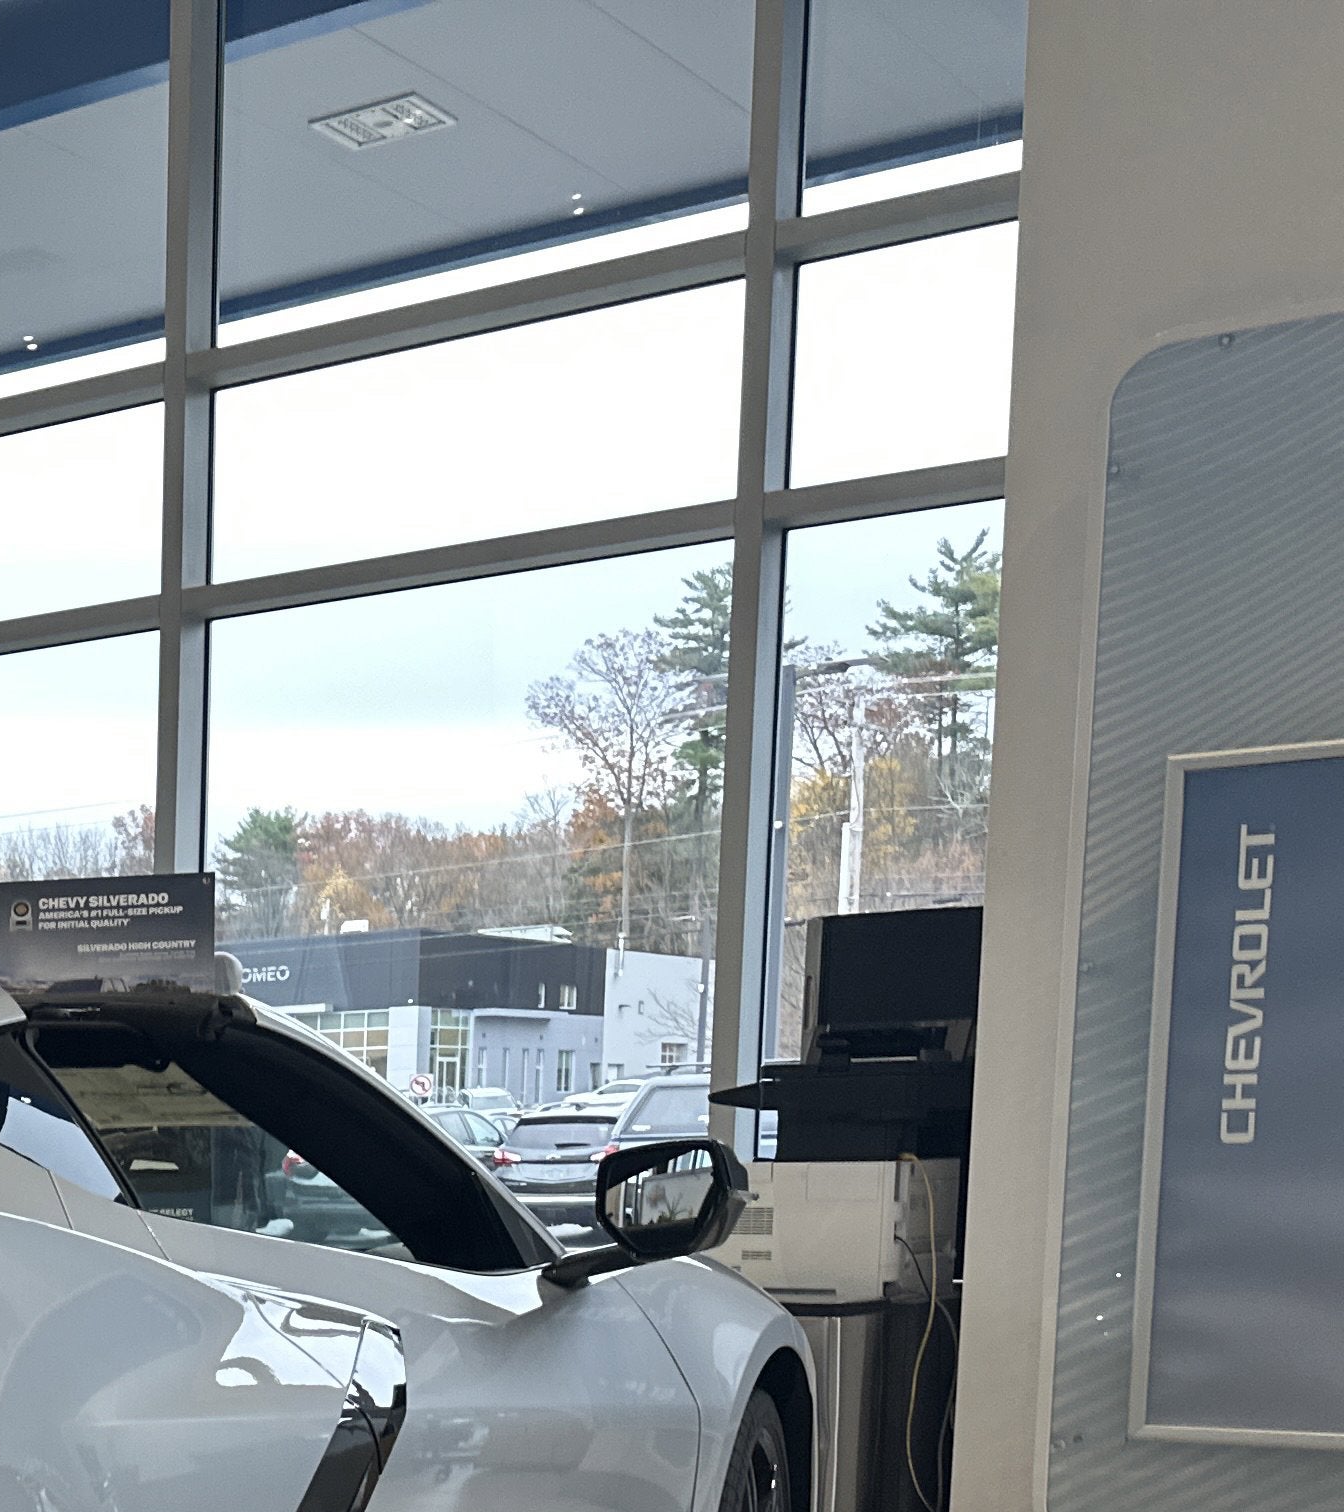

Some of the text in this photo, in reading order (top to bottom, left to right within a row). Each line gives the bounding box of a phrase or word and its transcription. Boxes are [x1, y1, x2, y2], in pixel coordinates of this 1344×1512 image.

[38, 893, 169, 911] CHEVY SILVERADO
[38, 908, 88, 920] AMERICA'S
[102, 906, 148, 918] FULL-SIZE
[149, 905, 184, 916] PICKUP
[38, 918, 129, 931] FOR INITIAL QUALITY
[77, 939, 197, 954] SILVERADO HIGH COUNTRY
[242, 965, 291, 984] OMEO
[1218, 822, 1277, 1145] CHEVROLET
